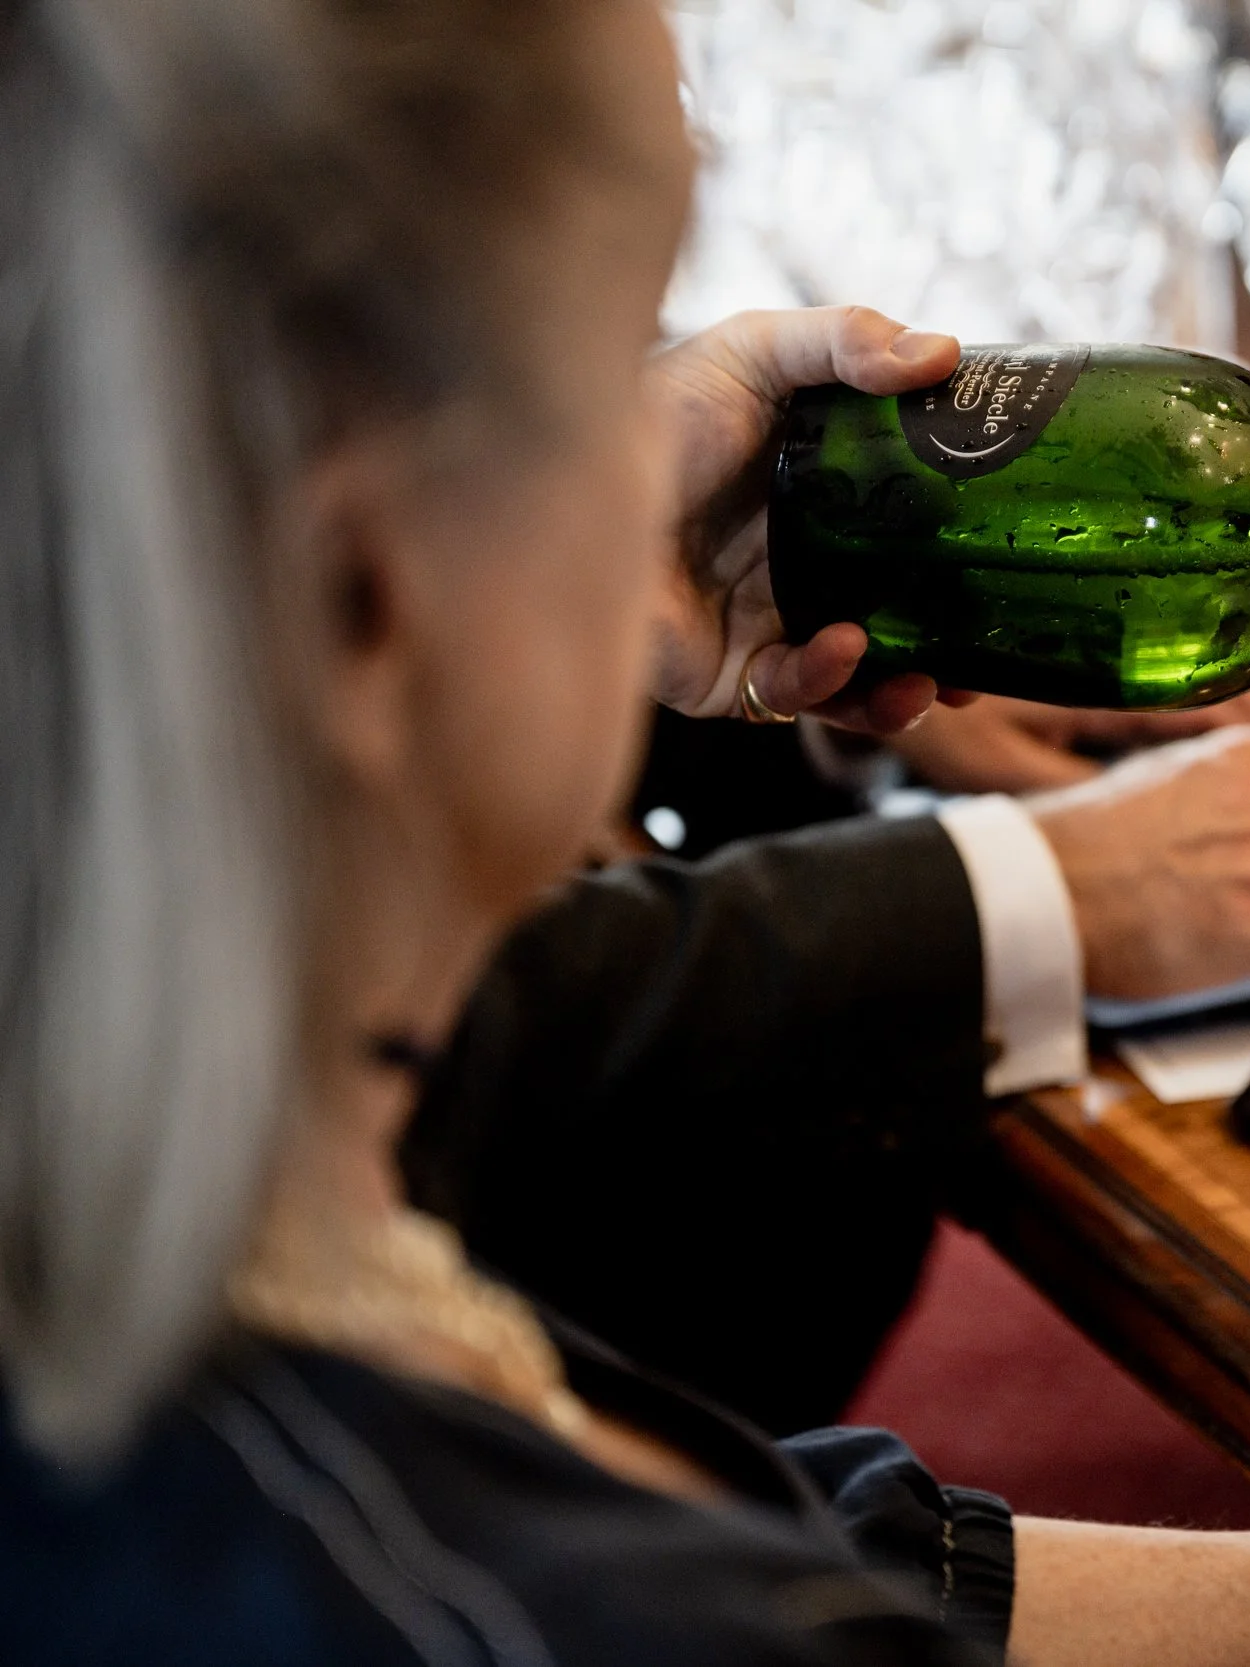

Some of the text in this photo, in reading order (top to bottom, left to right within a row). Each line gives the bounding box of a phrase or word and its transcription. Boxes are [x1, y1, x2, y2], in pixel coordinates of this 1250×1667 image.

[961, 352, 994, 405] aurent-Perrier
[983, 375, 1022, 434] Siècle
[1023, 353, 1061, 410] AMPAGNE
